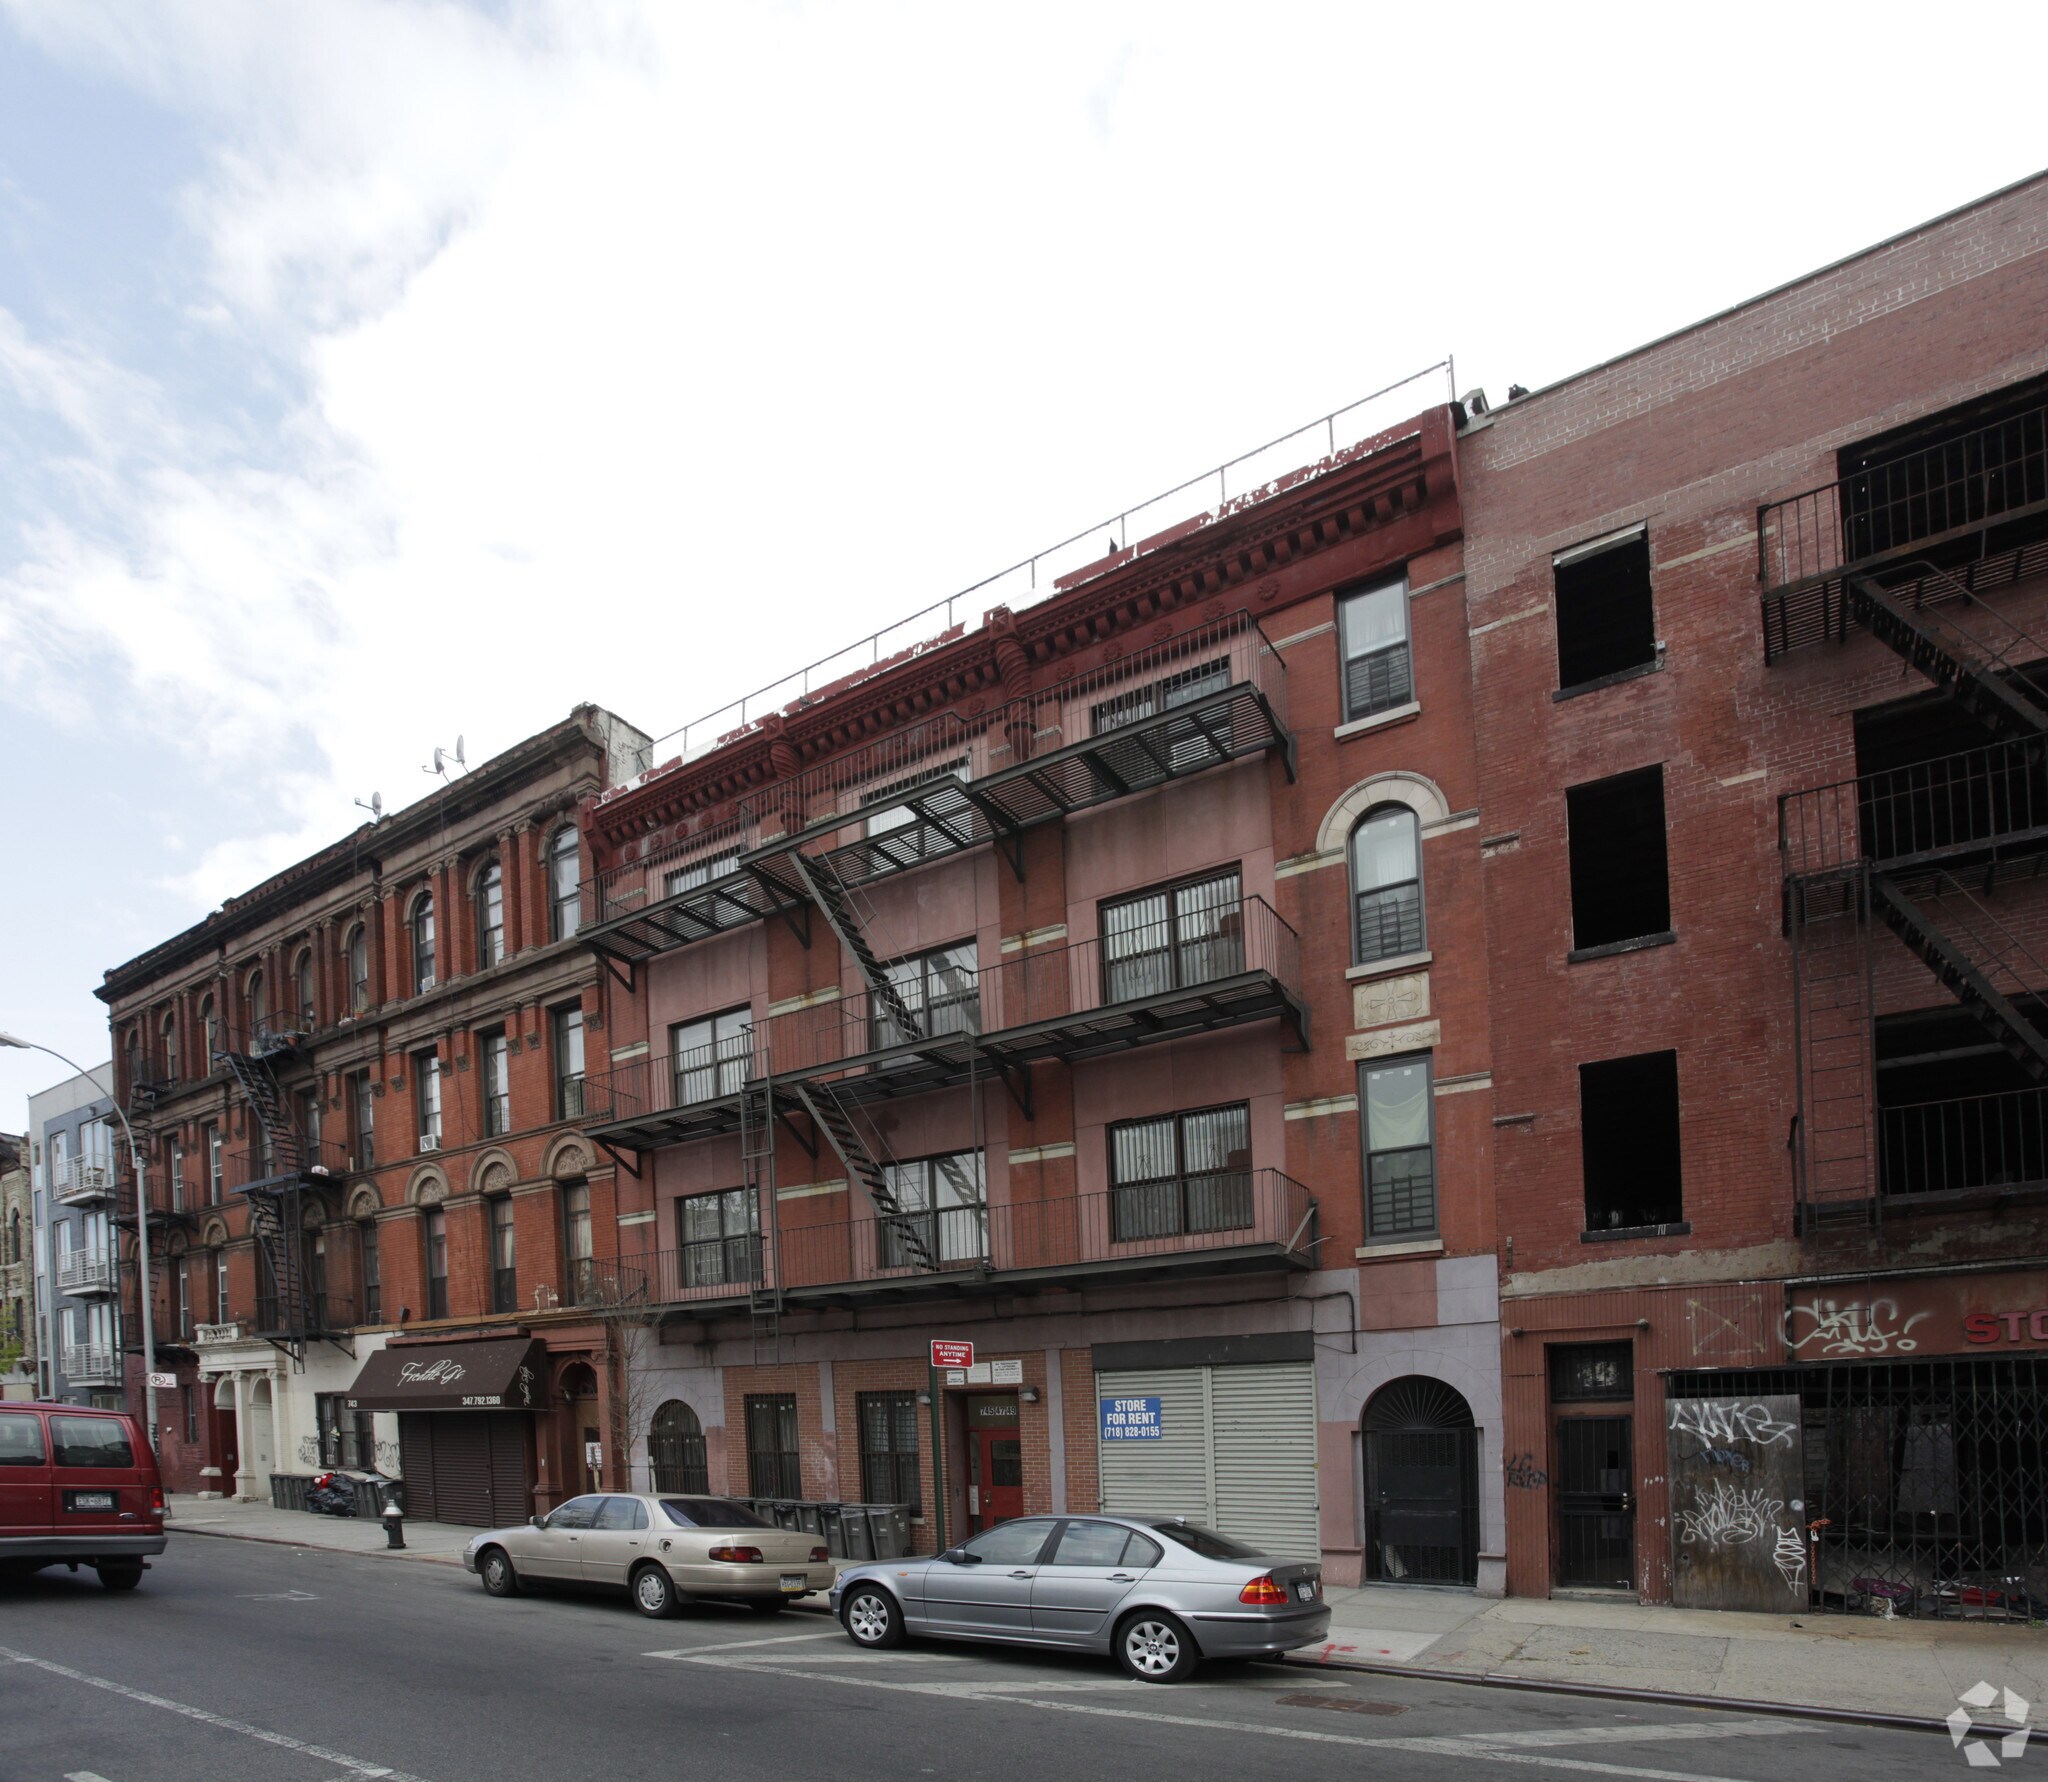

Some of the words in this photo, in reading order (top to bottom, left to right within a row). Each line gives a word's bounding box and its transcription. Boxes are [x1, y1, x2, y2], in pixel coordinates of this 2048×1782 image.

[944, 1344, 969, 1352] STANDING
[347, 1400, 358, 1408] 743
[1114, 1399, 1147, 1412] STORE
[1106, 1412, 1127, 1425] FOR
[1128, 1411, 1156, 1425] RENT
[1104, 1426, 1124, 1439] (718)
[1124, 1425, 1160, 1437] 828-0155
